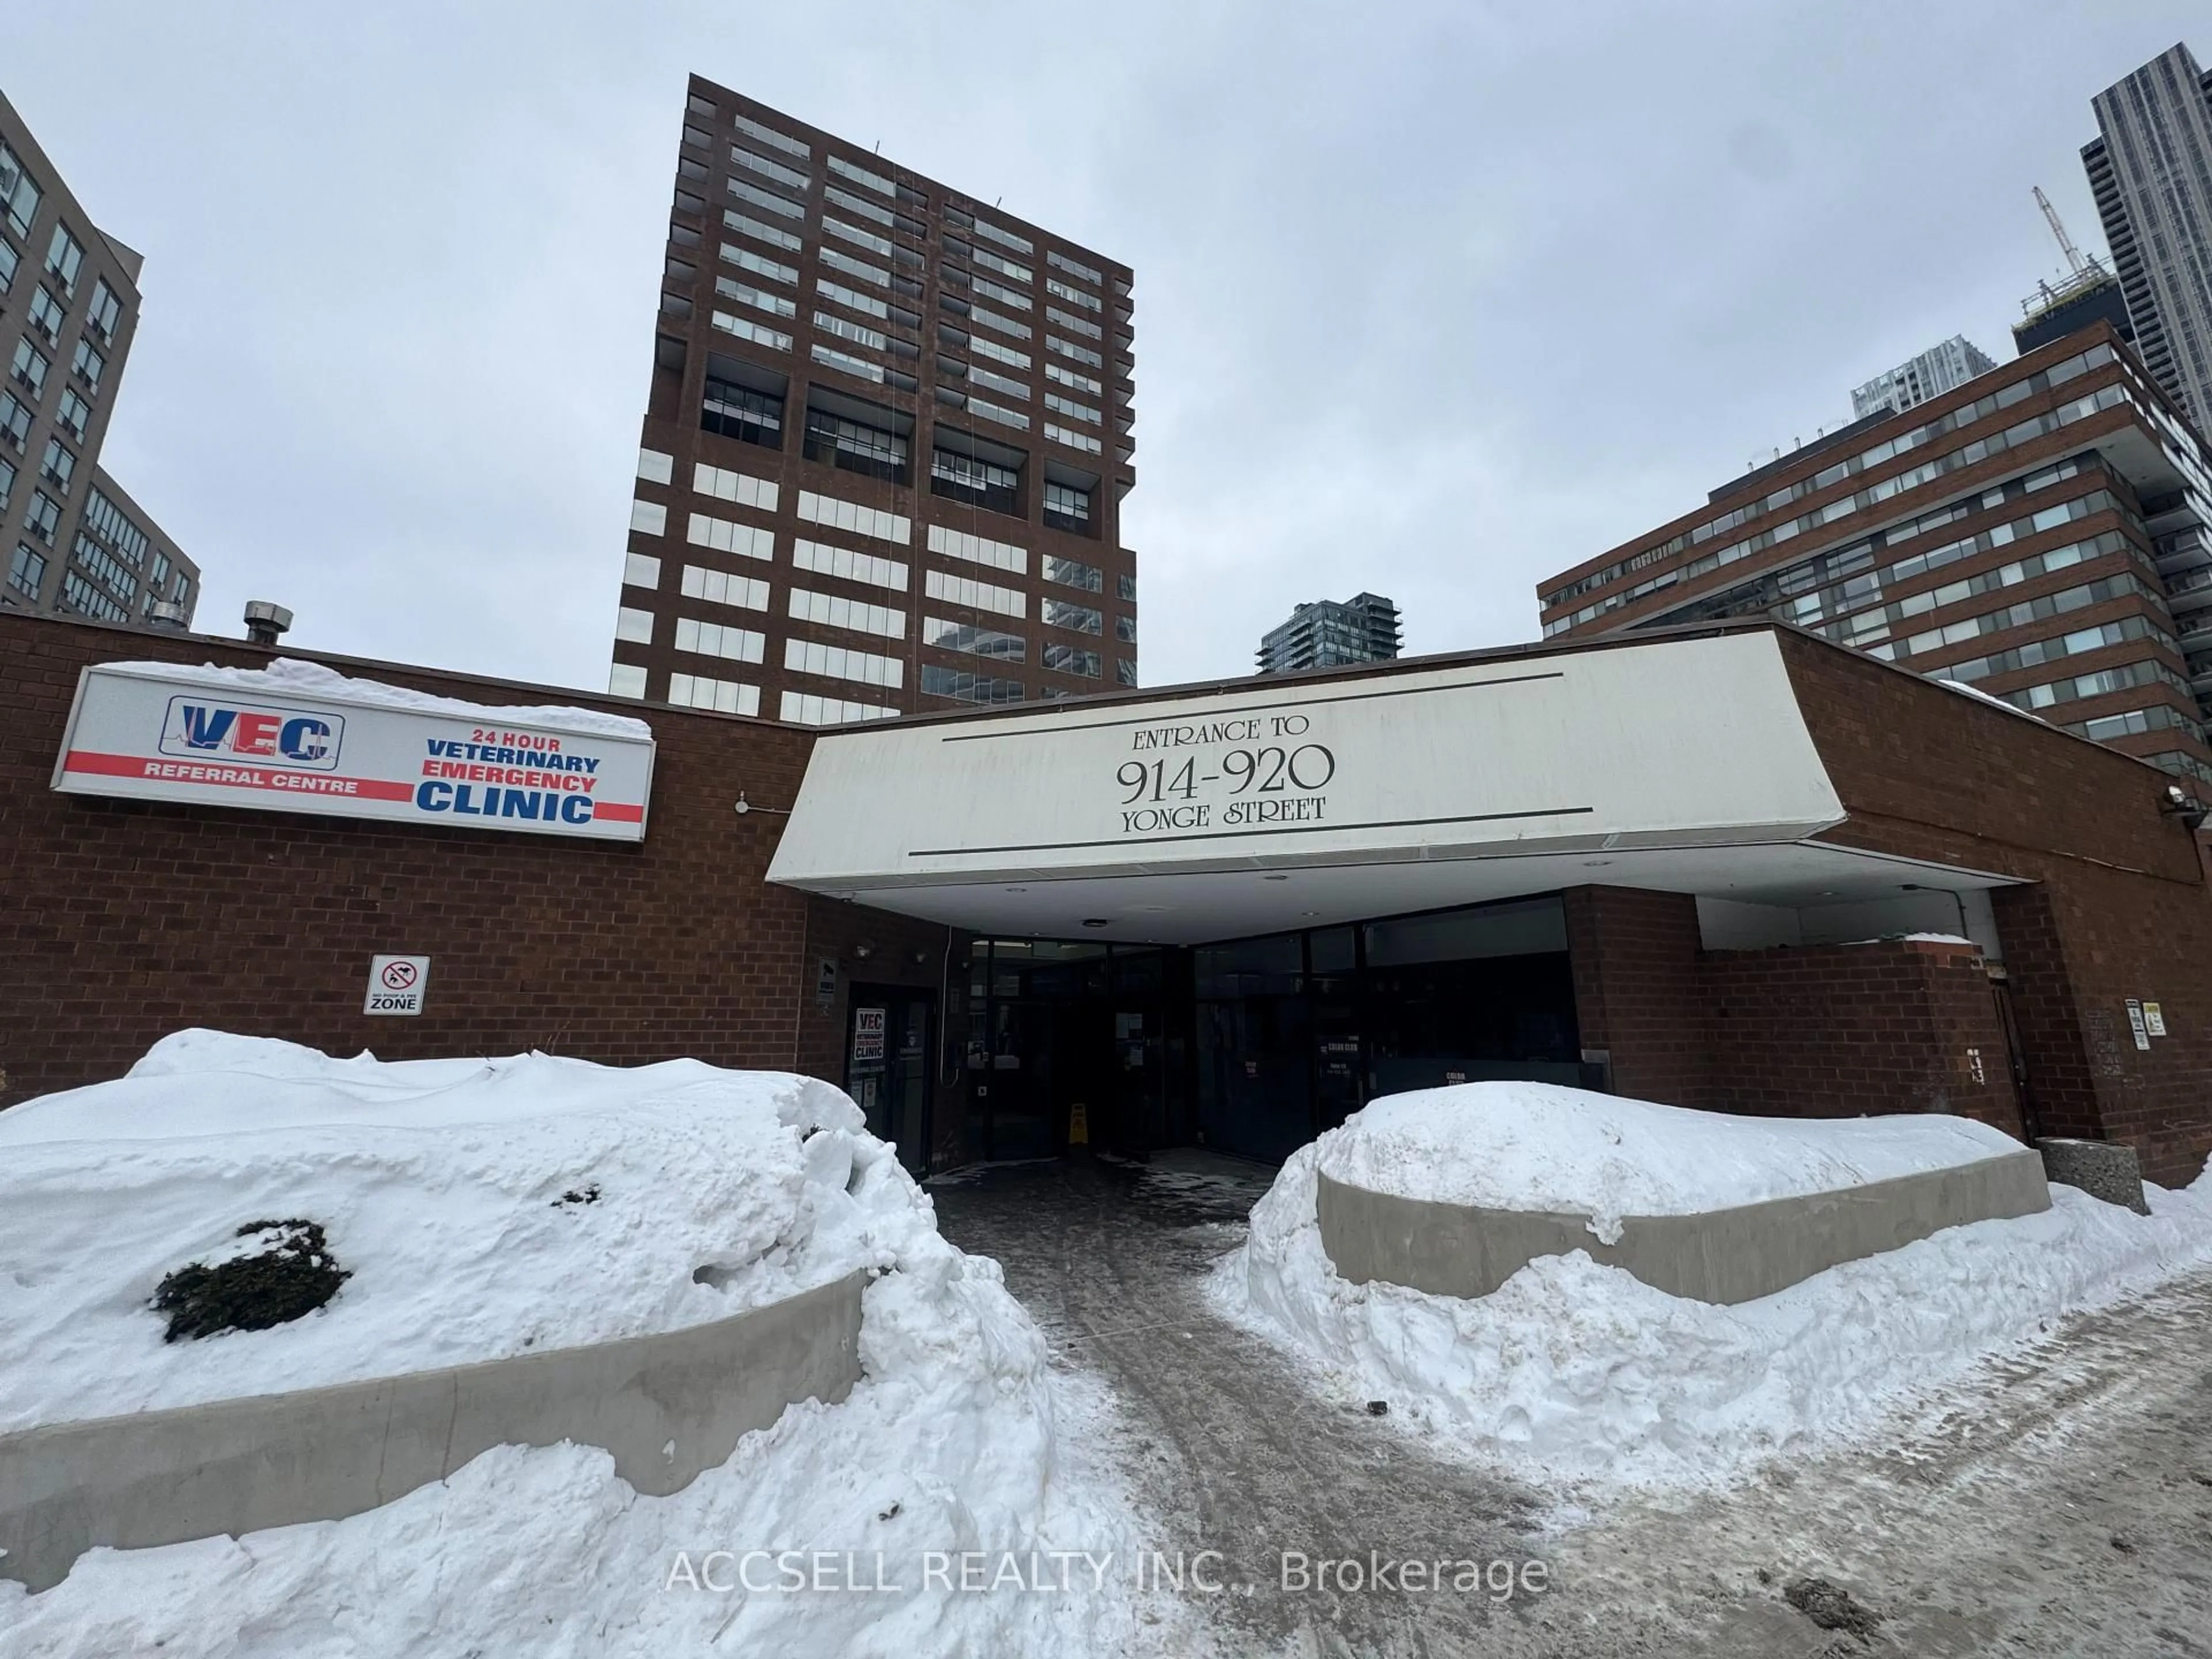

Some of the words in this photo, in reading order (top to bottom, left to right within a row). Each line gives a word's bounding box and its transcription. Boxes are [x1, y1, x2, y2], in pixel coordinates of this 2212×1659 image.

[183, 705, 330, 760] VEC
[471, 729, 497, 744] 24
[503, 733, 560, 752] HOUR
[1132, 719, 1261, 750] ENTRANCE
[1271, 715, 1309, 737] TO
[427, 738, 600, 774] VETERINARY
[145, 762, 265, 785] REFERRAL
[271, 774, 358, 794] CENTRE
[422, 759, 597, 793] EMERGENCY
[1116, 744, 1335, 804] 914-920
[417, 781, 593, 824] CLINIC
[1120, 804, 1210, 832] YONGE
[1223, 796, 1326, 824] STREET
[370, 998, 416, 1009] ZONE
[859, 1014, 882, 1029] VEC
[856, 1047, 882, 1058] CLINIC
